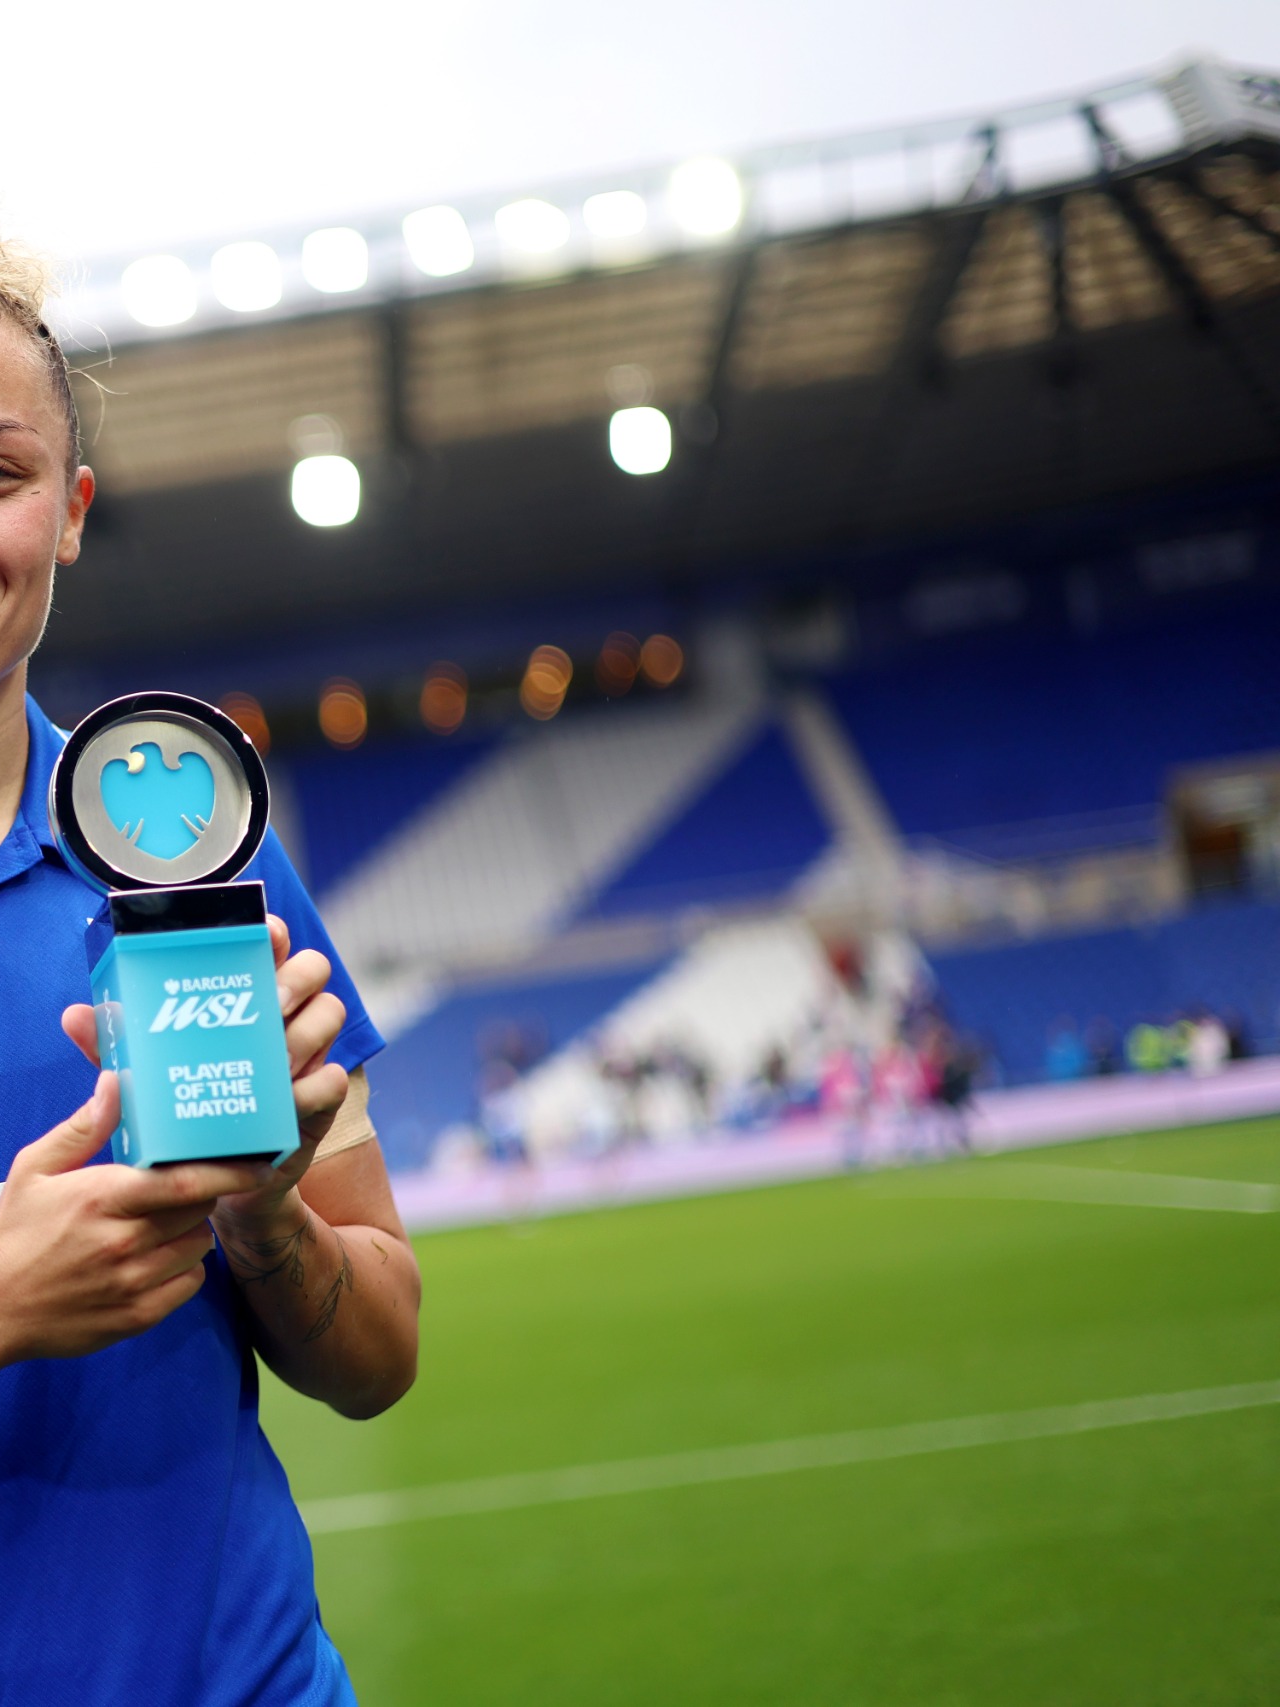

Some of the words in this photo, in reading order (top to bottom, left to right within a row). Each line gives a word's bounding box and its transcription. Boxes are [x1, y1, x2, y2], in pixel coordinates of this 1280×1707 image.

[182, 974, 253, 992] BARCLAYS
[148, 991, 260, 1034] WSL
[168, 1060, 254, 1082] PLAYER
[174, 1082, 204, 1100] OF
[207, 1078, 252, 1097] THE
[175, 1097, 257, 1119] MATCH
